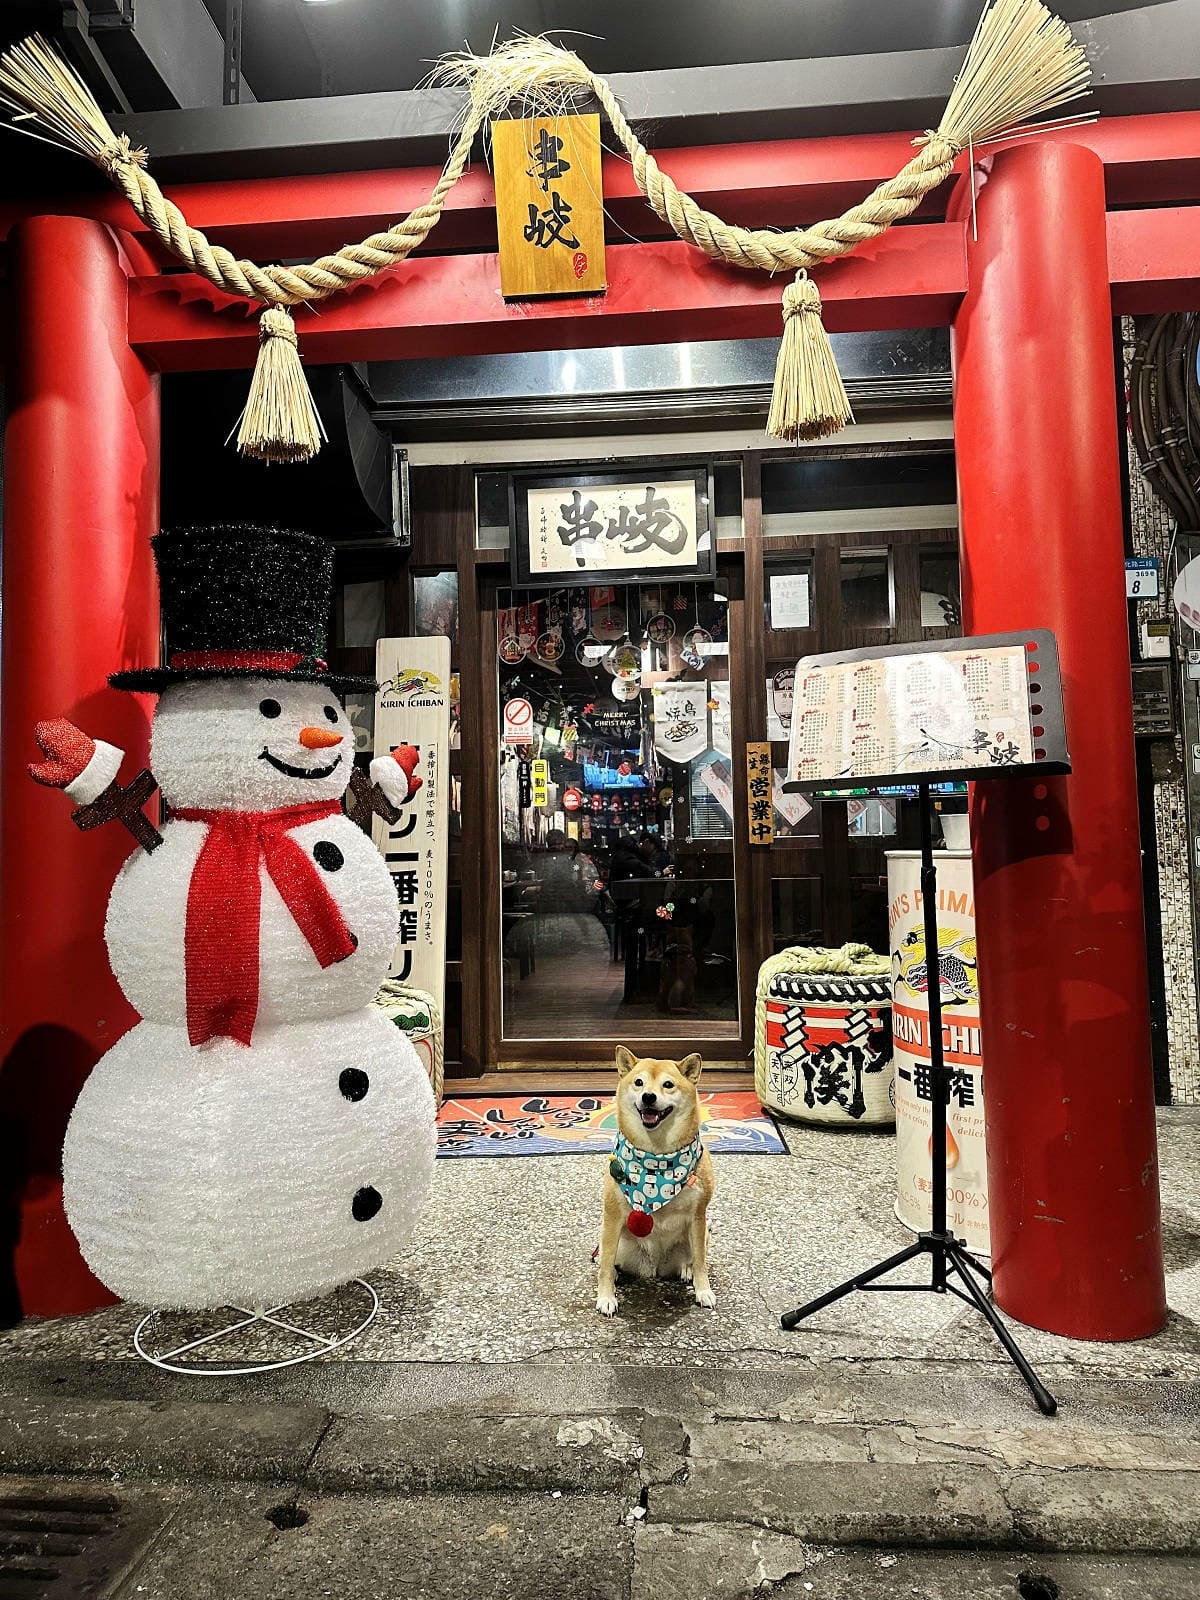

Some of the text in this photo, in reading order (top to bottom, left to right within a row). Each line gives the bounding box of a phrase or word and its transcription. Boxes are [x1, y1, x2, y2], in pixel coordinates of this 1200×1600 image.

[523, 128, 580, 250] 串岐
[1132, 580, 1141, 594] 8
[380, 698, 444, 709] KIRIN ICHIBAN
[594, 719, 636, 727] CHRISTMAS
[748, 750, 759, 770] 一生
[534, 763, 545, 803] 自動門
[749, 776, 772, 841] 営業中
[914, 889, 975, 918] PIM
[892, 1011, 922, 1046] IRIN
[952, 1113, 971, 1123] first
[973, 1118, 984, 1126] pr
